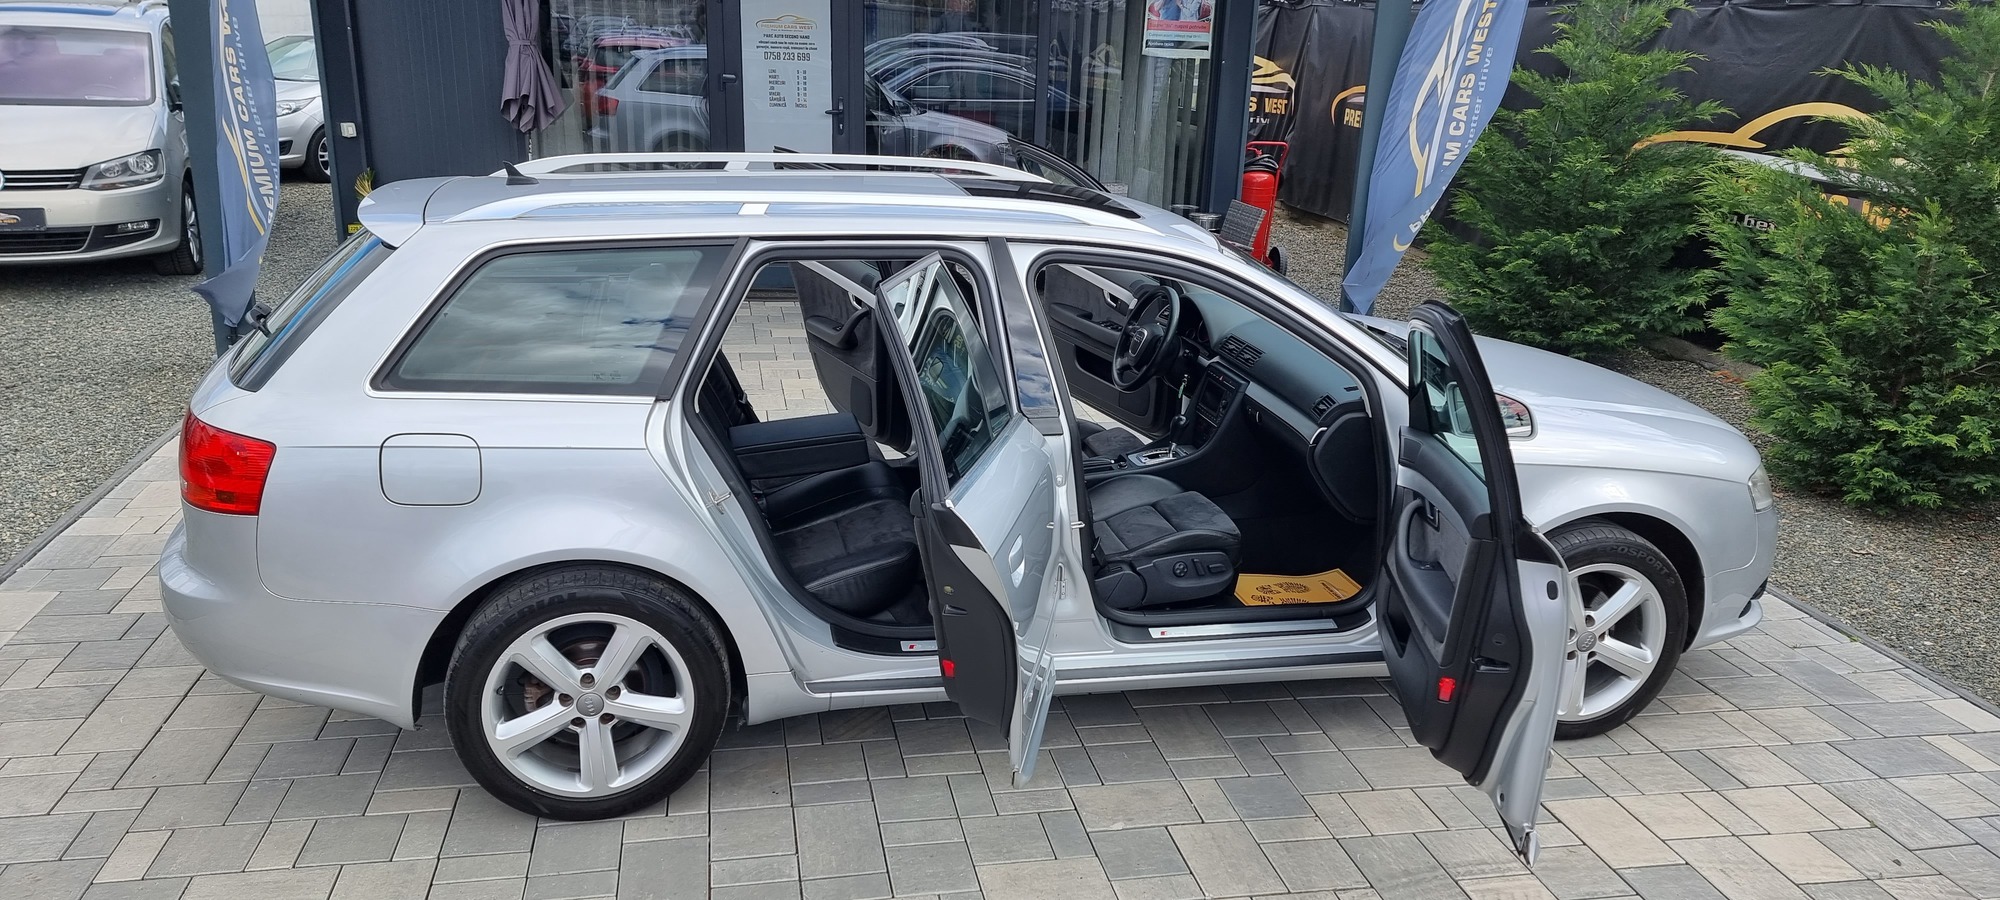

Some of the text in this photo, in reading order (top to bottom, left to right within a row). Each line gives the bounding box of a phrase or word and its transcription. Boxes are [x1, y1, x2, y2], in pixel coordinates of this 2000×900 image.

[764, 51, 811, 62] 0758 233 699
[1449, 73, 1475, 136] CARS
[1465, 0, 1497, 66] WEST
[1478, 47, 1494, 91] drive
[225, 47, 249, 122] CARS
[1249, 116, 1270, 124] riv
[1343, 107, 1363, 128] PRE
